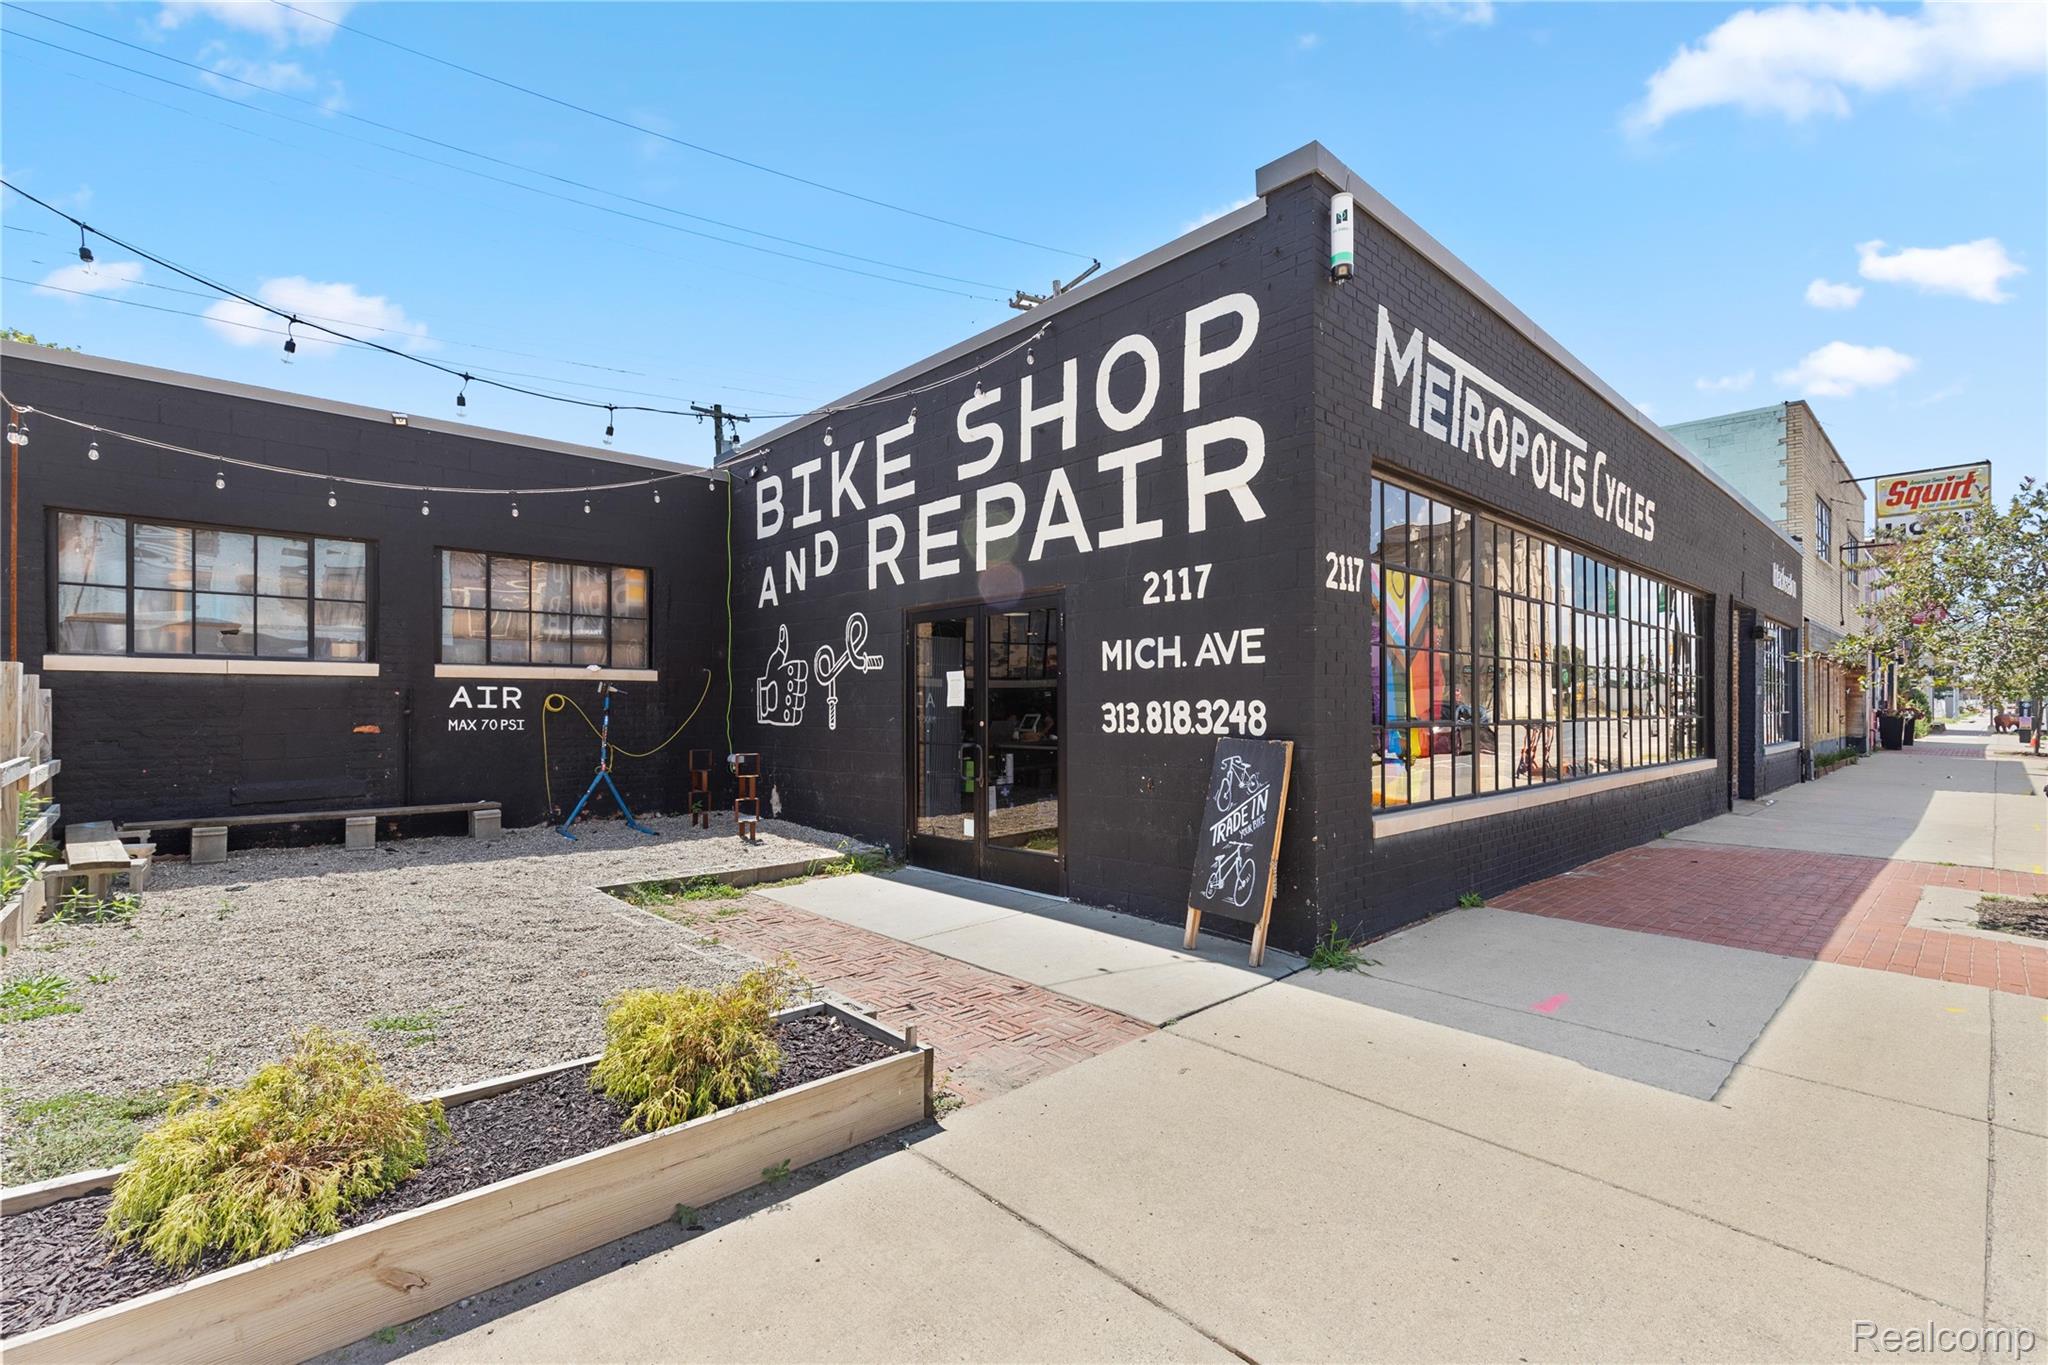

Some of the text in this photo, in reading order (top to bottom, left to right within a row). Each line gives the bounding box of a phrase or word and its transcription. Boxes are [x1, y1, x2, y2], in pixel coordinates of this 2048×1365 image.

[756, 292, 1260, 540] BIKE SHOP
[1372, 303, 1656, 542] METROPOLIS CYCLES
[1886, 470, 1977, 510] Squirt
[758, 416, 1266, 608] AND REPAIR
[1142, 563, 1212, 605] 2117
[1325, 551, 1364, 593] 2117
[1101, 628, 1266, 671] MICH. AVE
[448, 685, 522, 709] AIR
[1101, 699, 1267, 736] 313.818.3248
[448, 719, 525, 731] MAX 70 PSI
[1210, 789, 1269, 846] TRADE IN
